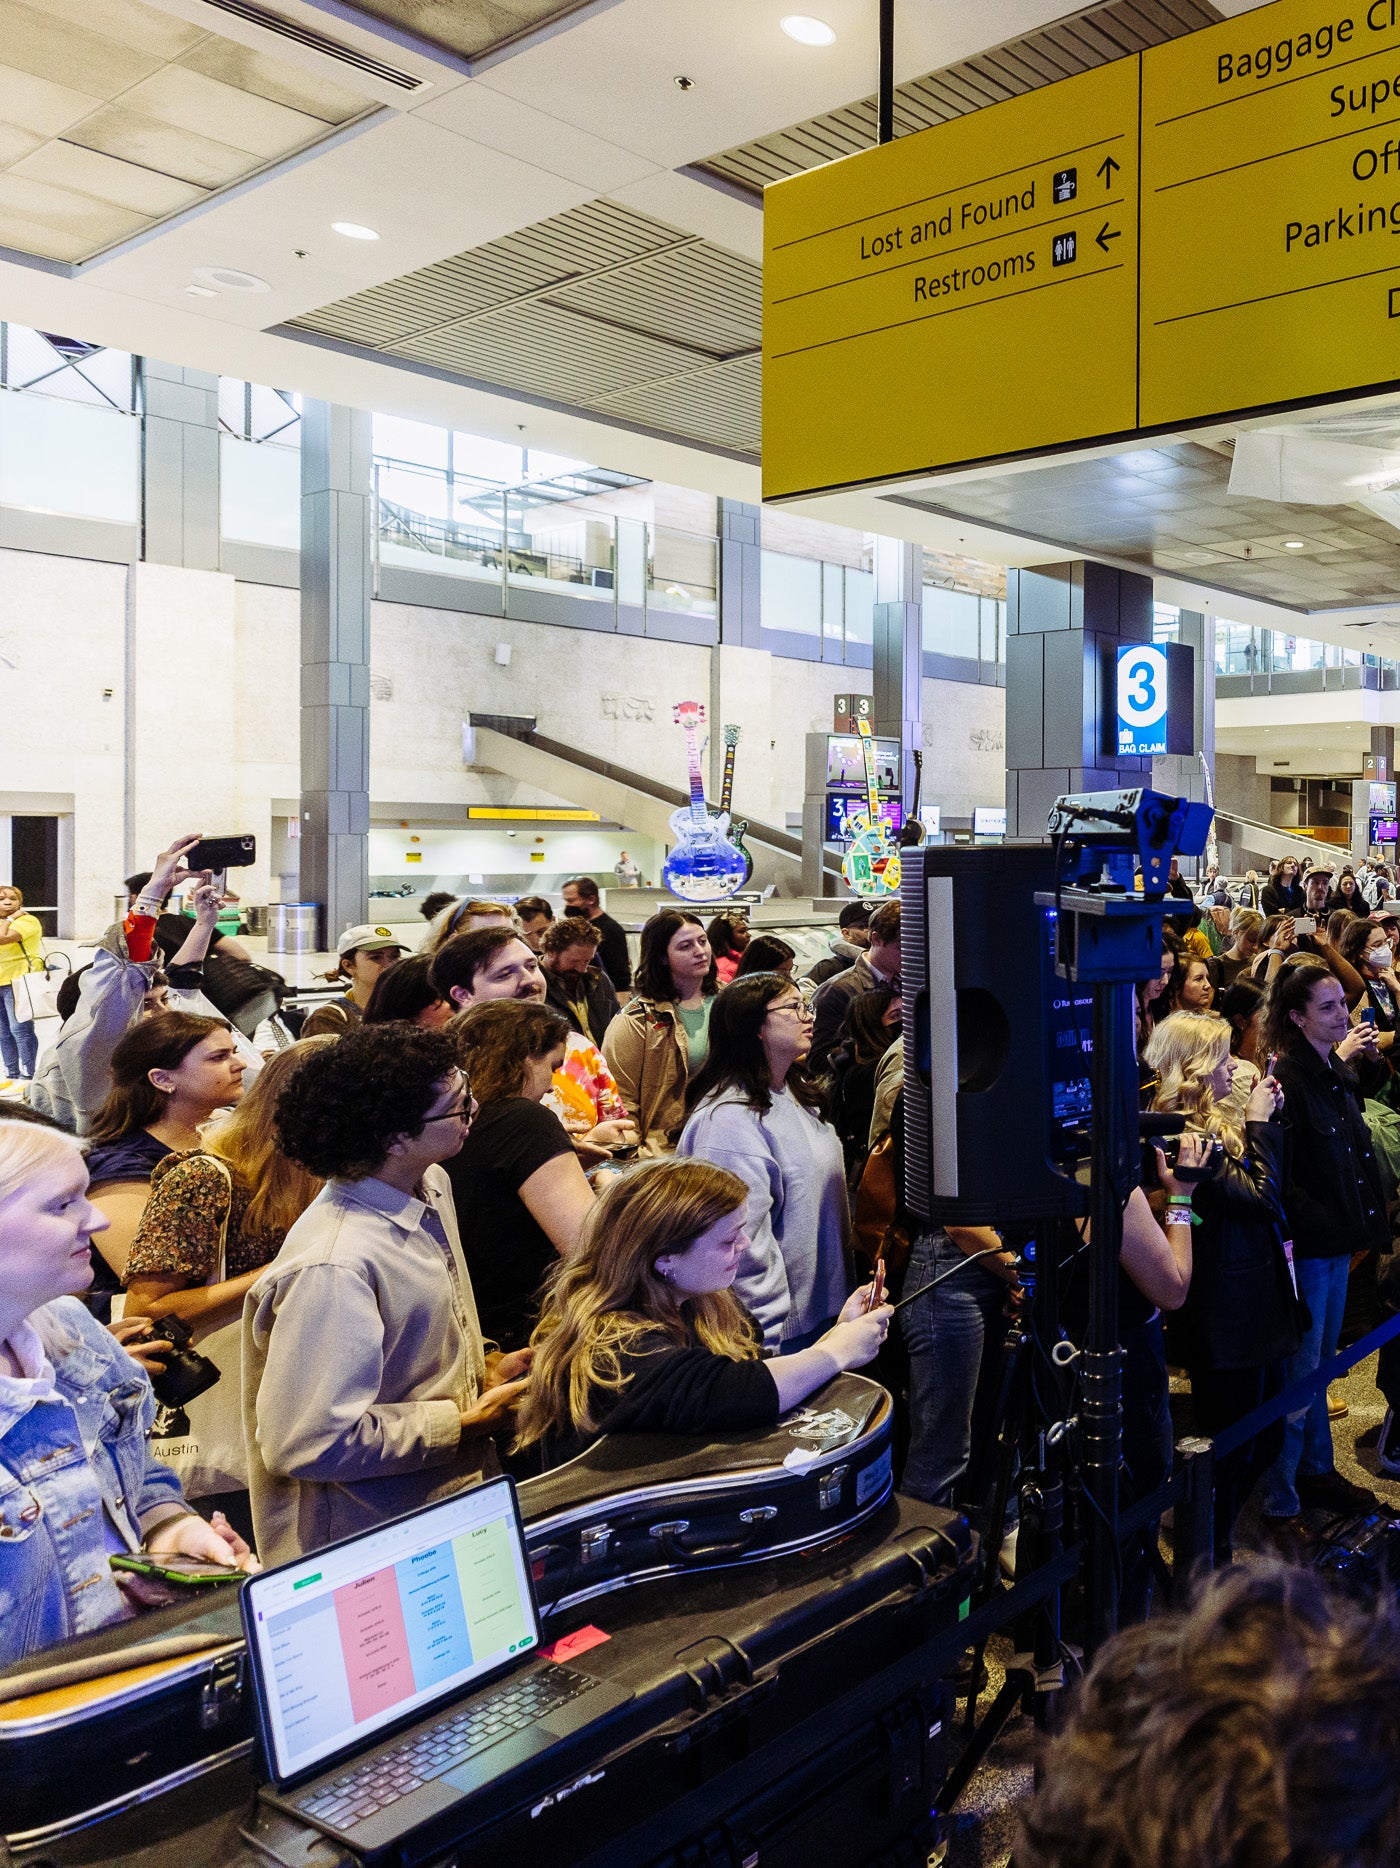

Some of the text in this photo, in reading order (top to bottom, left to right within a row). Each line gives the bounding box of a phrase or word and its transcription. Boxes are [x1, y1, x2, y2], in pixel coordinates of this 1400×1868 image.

[1217, 18, 1354, 84] Baggage
[860, 181, 1035, 260] Lost and Found
[914, 251, 1036, 302] Restrooms
[1128, 661, 1156, 712] 3
[838, 698, 846, 713] 3
[859, 699, 869, 714] 3
[1119, 743, 1166, 753] BAG CLAIM
[1368, 759, 1374, 769] 2
[1380, 759, 1385, 769] 2
[832, 798, 844, 817] 3
[154, 1443, 199, 1458] Austin
[471, 1527, 487, 1538] Lucy
[411, 1549, 437, 1564] Phoebe
[354, 1576, 375, 1589] Julien
